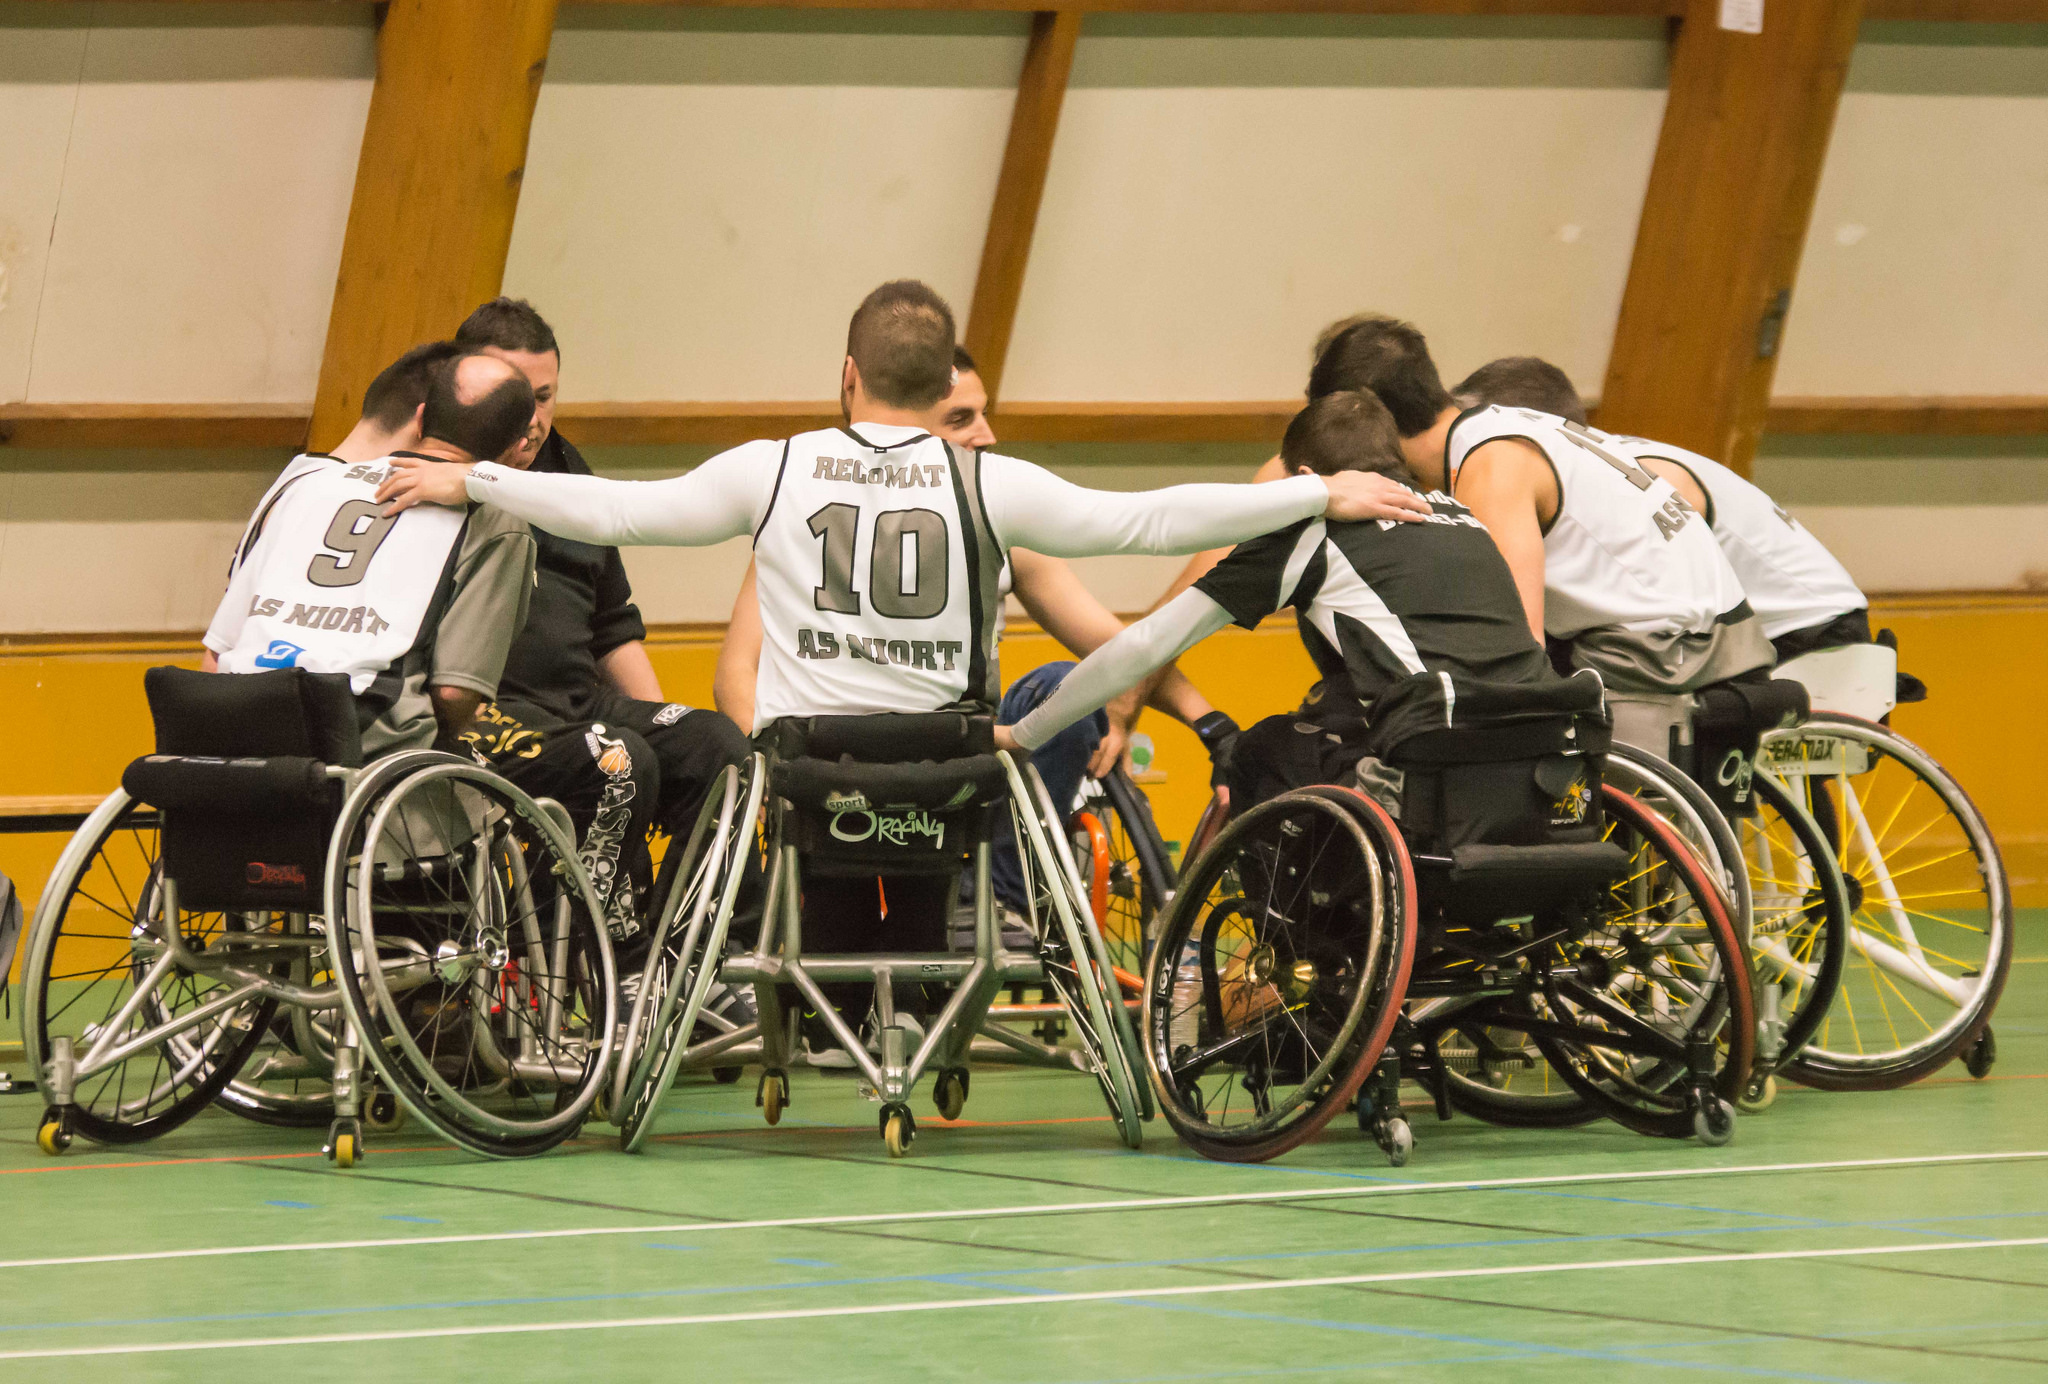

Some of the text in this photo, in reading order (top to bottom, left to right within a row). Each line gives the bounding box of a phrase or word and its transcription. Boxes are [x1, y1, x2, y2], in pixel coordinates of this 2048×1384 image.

[306, 499, 399, 588] 9
[806, 501, 949, 619] 10
[283, 602, 389, 637] NIORT
[796, 628, 962, 671] AS NIORT
[829, 797, 864, 810] sport
